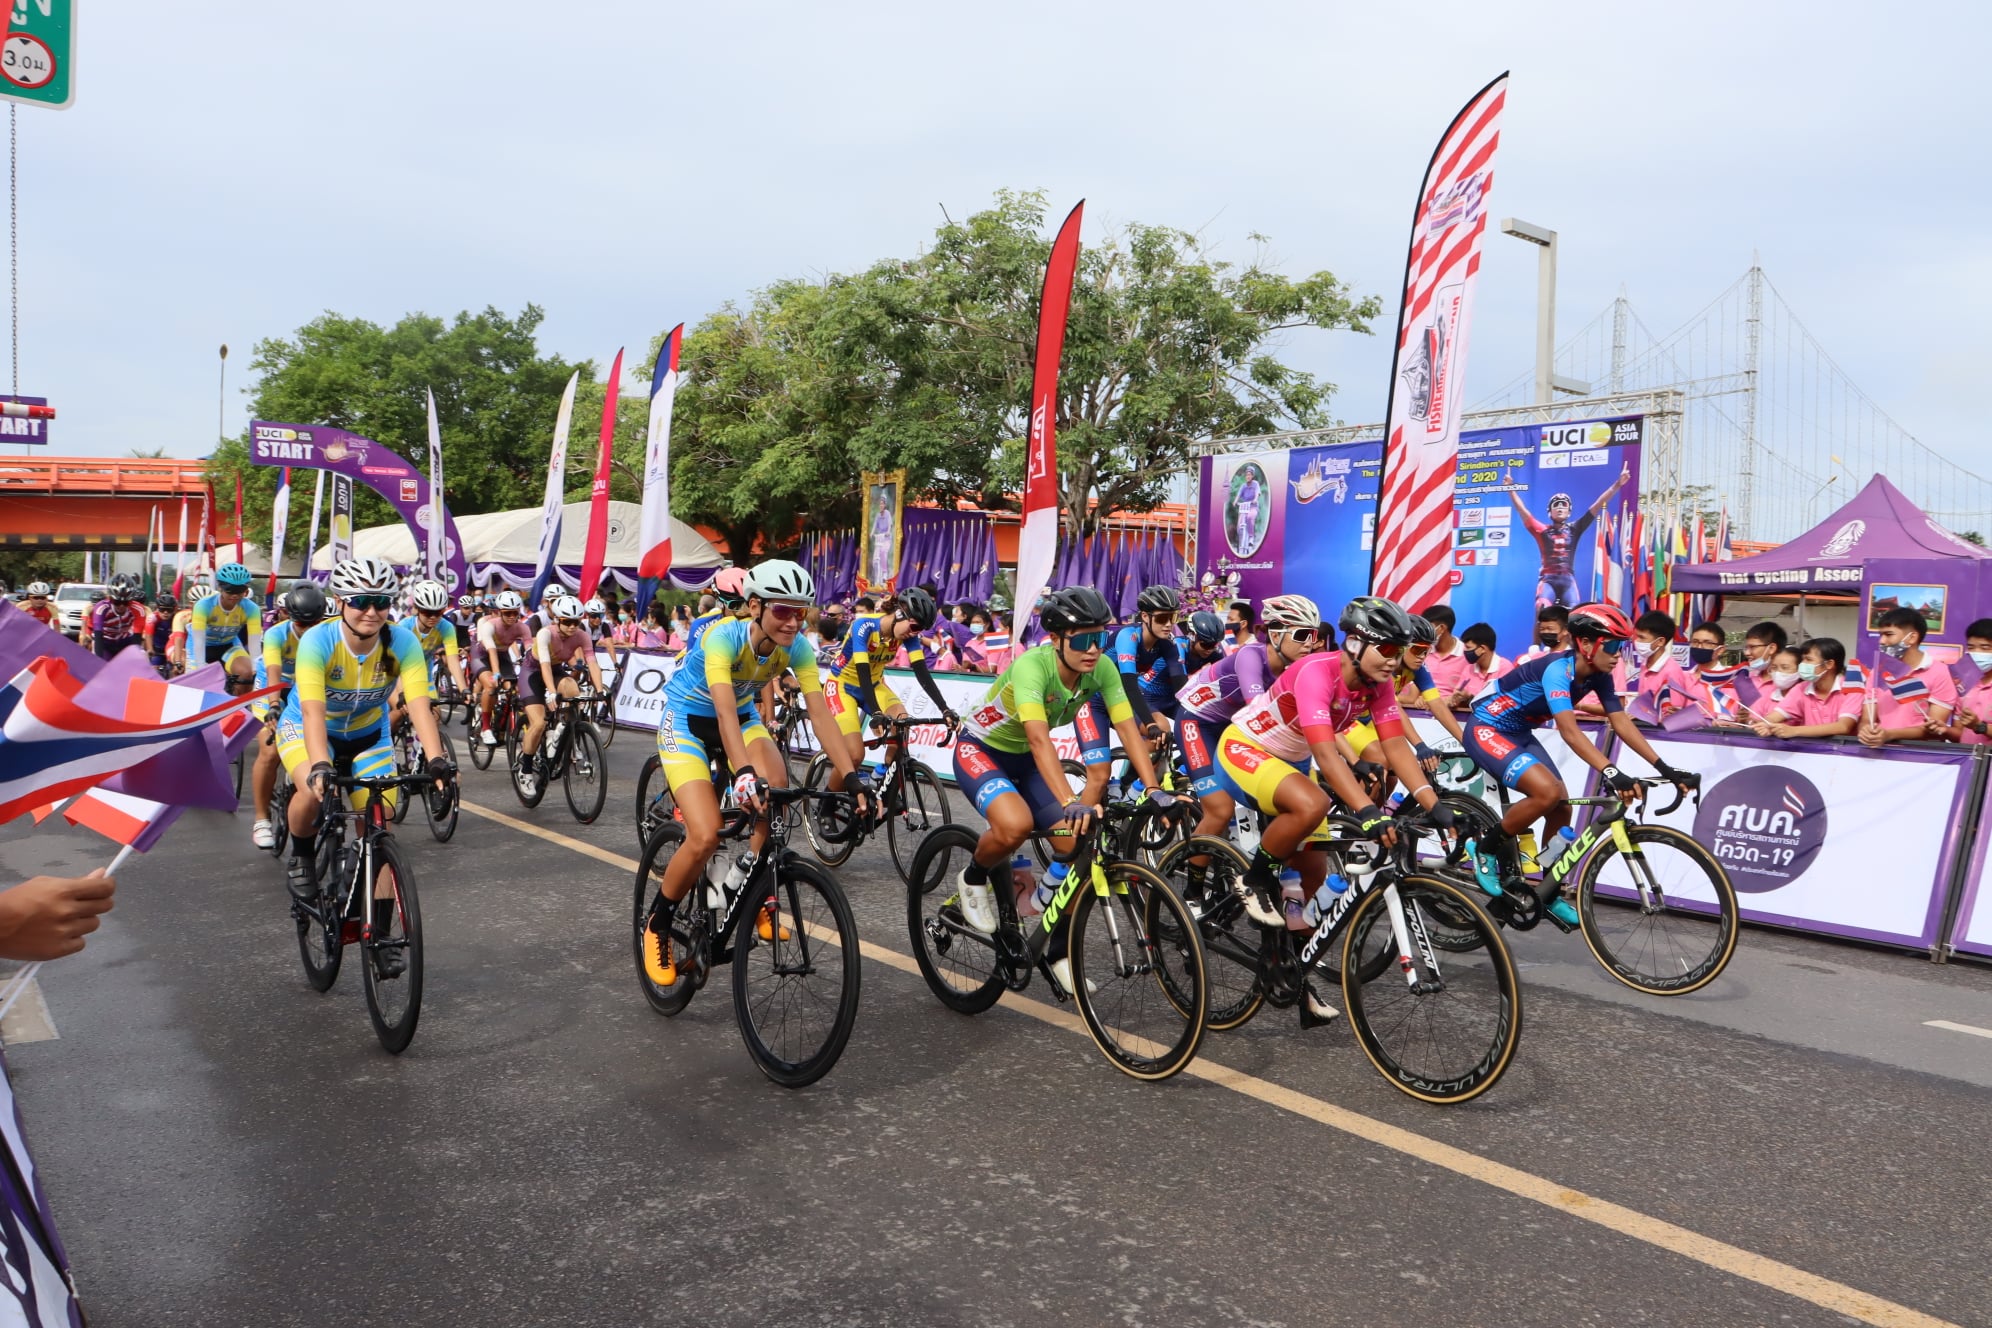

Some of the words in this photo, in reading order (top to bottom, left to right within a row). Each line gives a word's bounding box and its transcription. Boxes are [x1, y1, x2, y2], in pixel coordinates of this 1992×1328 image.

[262, 429, 282, 438] UCI
[1550, 428, 1585, 446] UCI
[1615, 424, 1636, 433] ASIA
[1615, 432, 1639, 442] TOUR
[258, 441, 314, 460] START
[1460, 460, 1505, 470] Sirindhorn's
[1508, 459, 1524, 468] Cup
[1472, 472, 1497, 482] 2020
[1719, 572, 1749, 584] Thai
[1754, 570, 1808, 584] Cycling
[1815, 568, 1863, 581] Associ
[1356, 623, 1387, 640] RUDY
[619, 694, 668, 712] OAKLEY
[1507, 756, 1533, 777] TCA
[977, 780, 1009, 803] TCA
[1487, 784, 1498, 793] 2
[1238, 815, 1251, 834] 12
[1718, 803, 1801, 836] ศบค.
[1552, 826, 1596, 882] RACE
[1713, 838, 1795, 866] โควิด-19
[1042, 864, 1081, 933] RACE
[1301, 883, 1359, 963] CIPOLLINI
